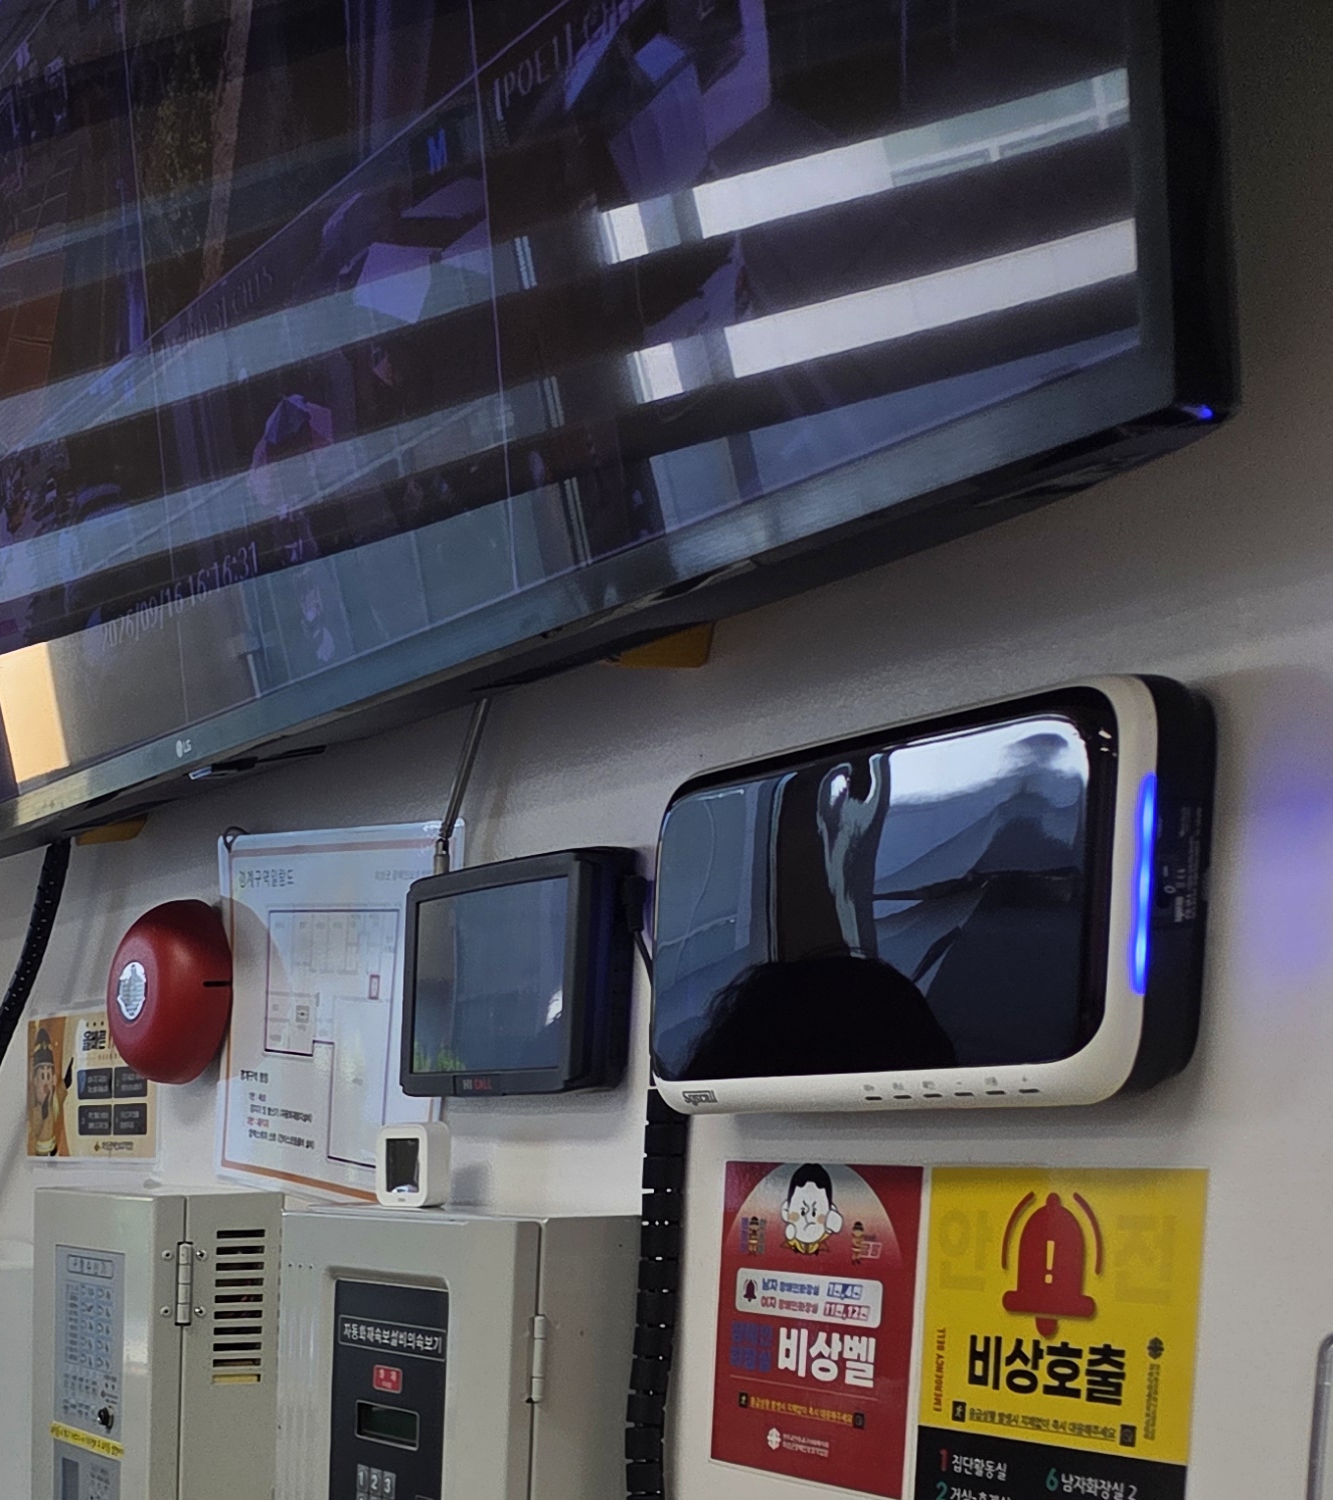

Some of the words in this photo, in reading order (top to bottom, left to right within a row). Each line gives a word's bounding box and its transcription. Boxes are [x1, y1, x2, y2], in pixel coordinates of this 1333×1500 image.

[187, 541, 258, 607] 16:16:31
[777, 1327, 877, 1388] 비상벨
[968, 1334, 1126, 1406] 비상호출
[359, 1471, 365, 1486] 1
[371, 1474, 378, 1490] 2
[384, 1478, 391, 1493] 3
[939, 1449, 948, 1472] 1
[951, 1454, 1008, 1481] 집단활동실
[1045, 1467, 1059, 1491] 6
